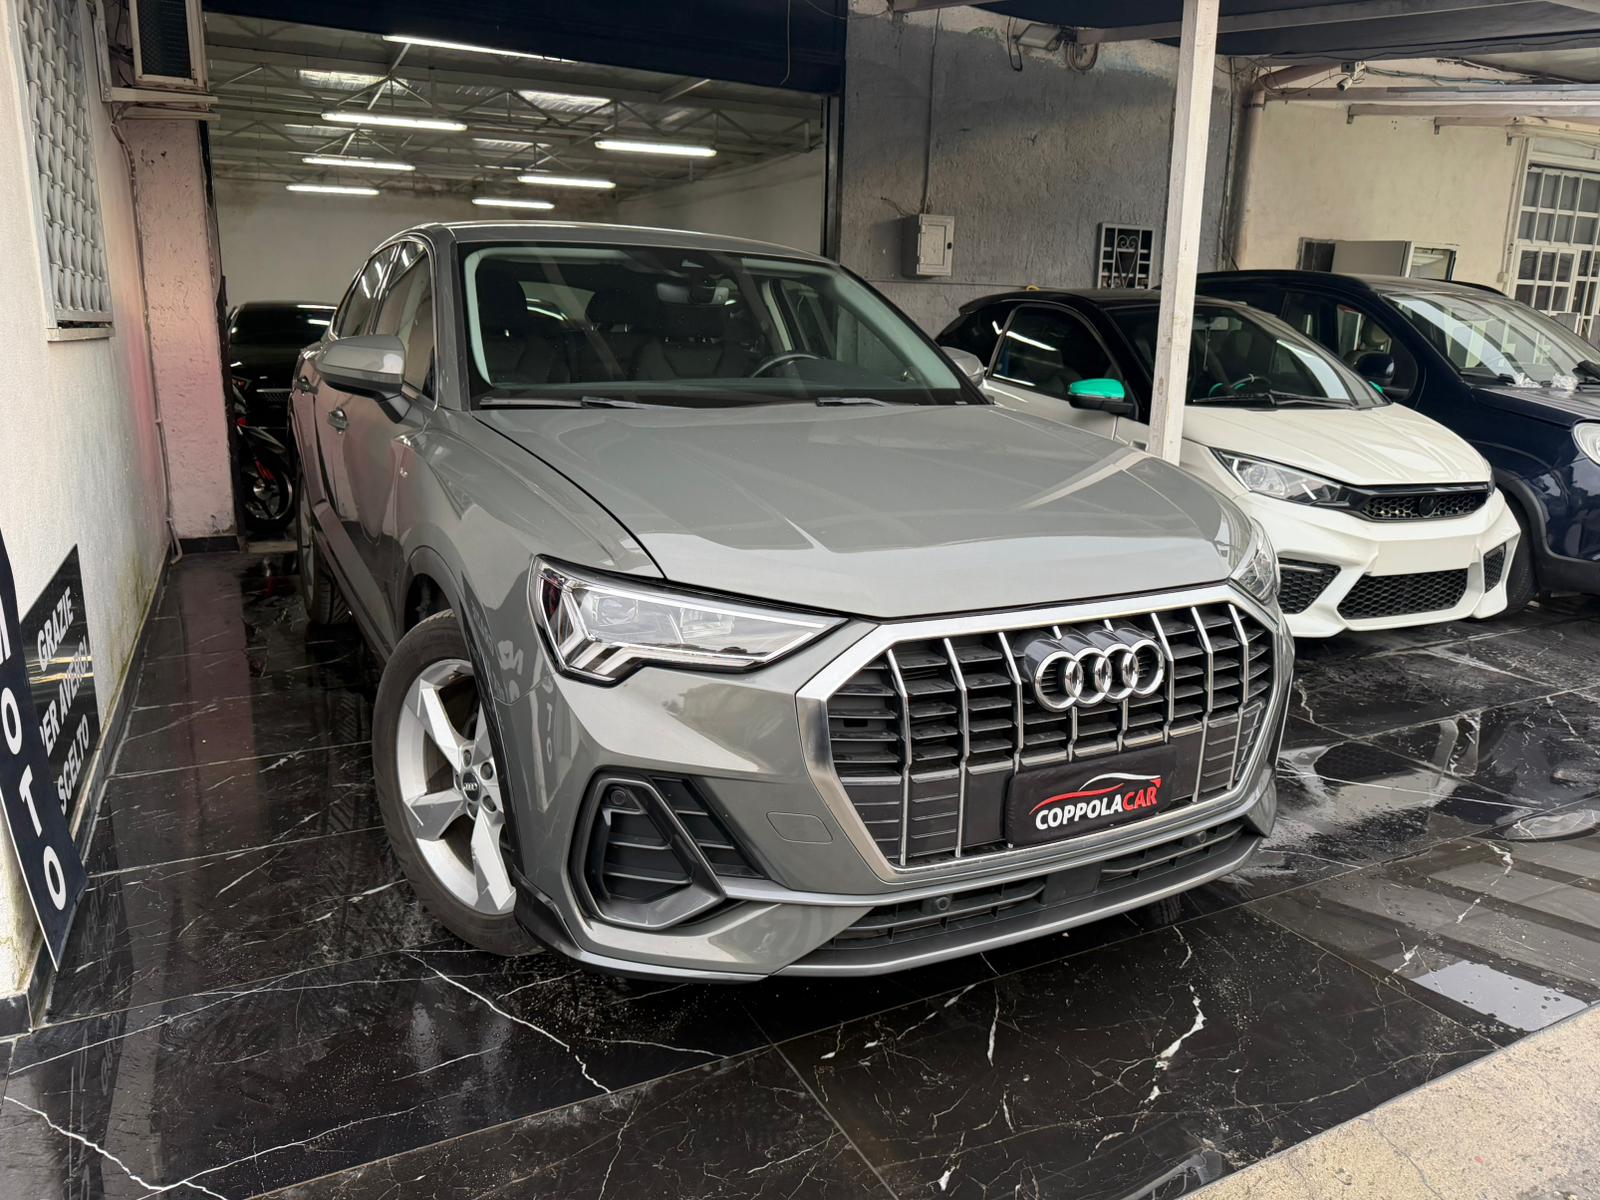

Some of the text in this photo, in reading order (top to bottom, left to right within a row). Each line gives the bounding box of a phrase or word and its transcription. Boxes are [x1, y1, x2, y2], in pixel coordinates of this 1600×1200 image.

[37, 586, 74, 672] GRAZIE
[39, 634, 90, 758] ER AVERCI
[57, 713, 90, 816] SCELTO
[1035, 786, 1158, 830] COPPOLACAR
